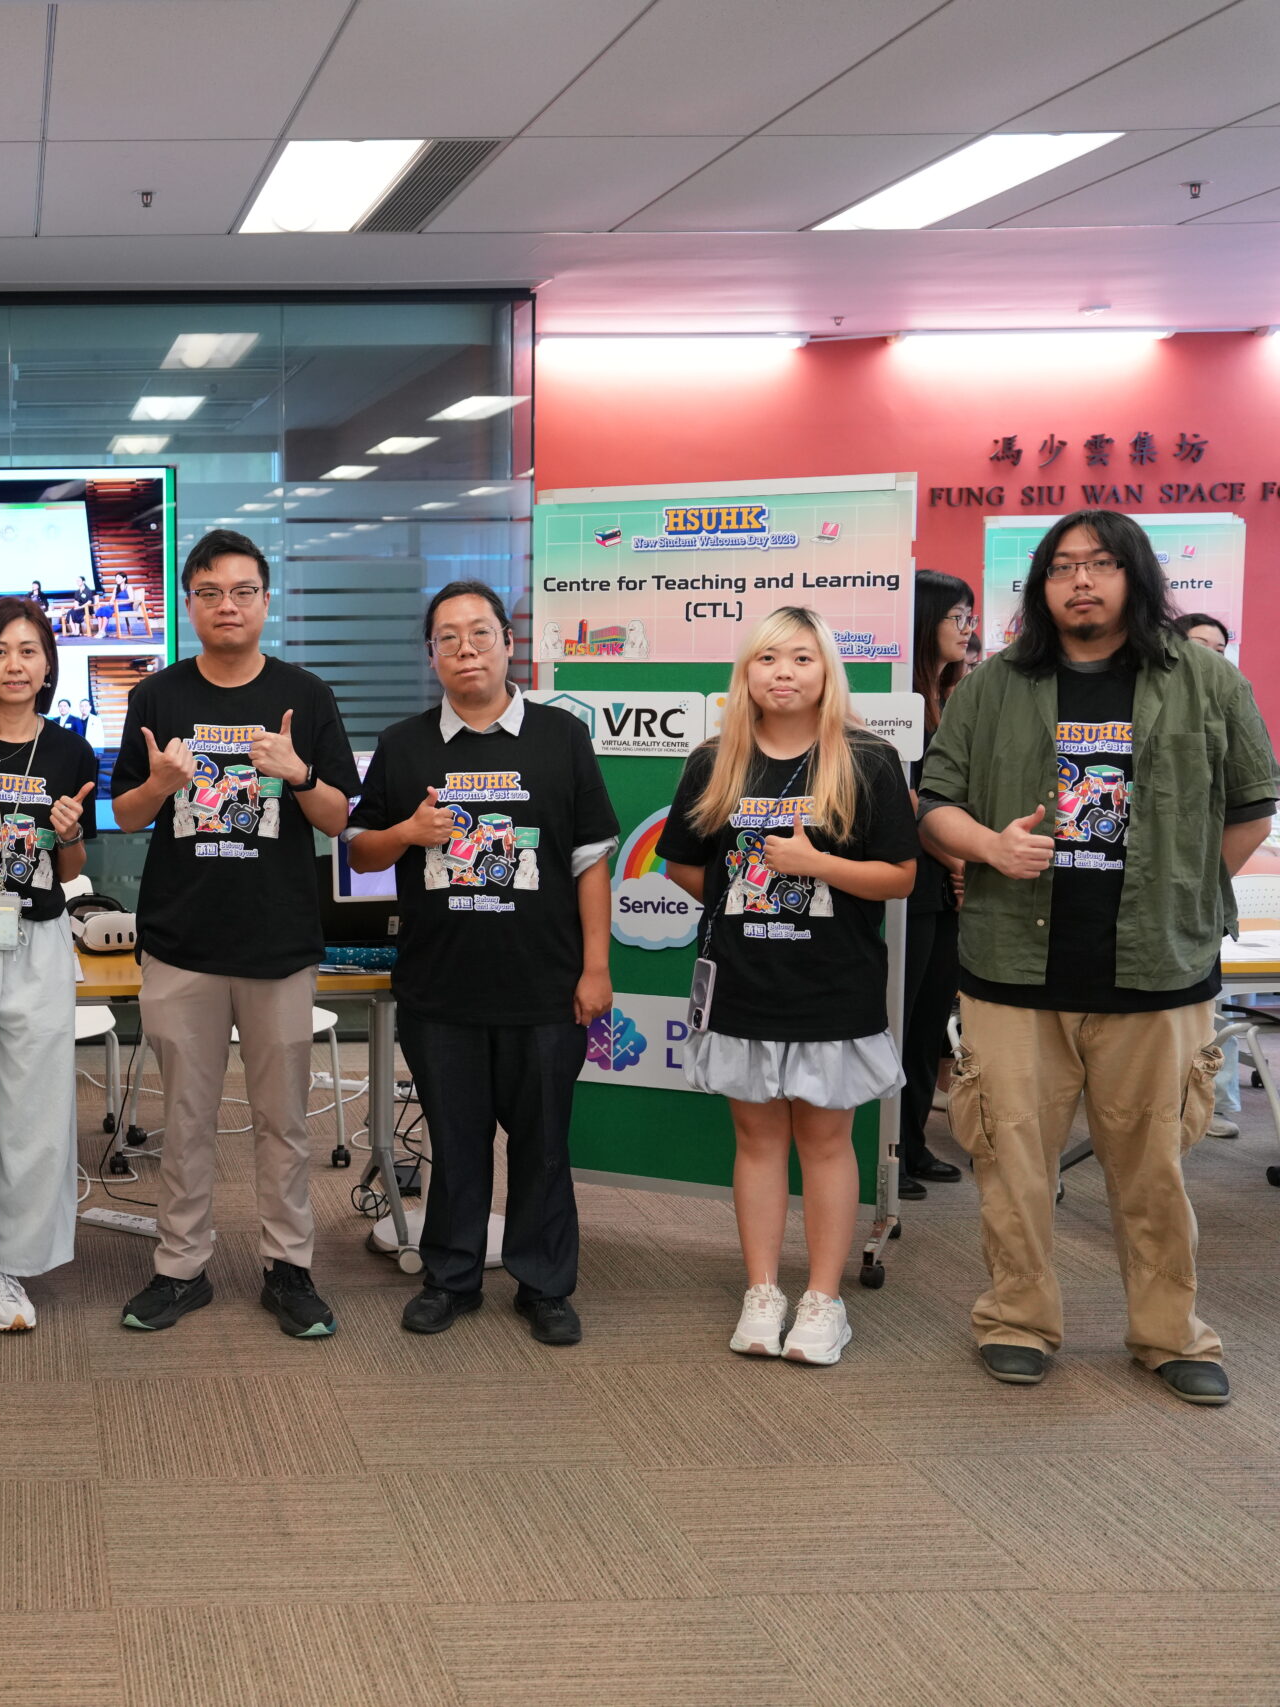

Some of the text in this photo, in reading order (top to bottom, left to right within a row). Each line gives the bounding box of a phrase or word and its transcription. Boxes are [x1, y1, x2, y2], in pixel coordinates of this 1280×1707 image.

[989, 431, 1209, 468] 馮少雲集坊
[929, 486, 1005, 507] FUNG
[1020, 485, 1066, 506] SIU
[1082, 484, 1144, 505] WAN
[1158, 482, 1246, 504] SPACE
[665, 506, 766, 535] HSUHK
[634, 534, 796, 548] New Student Welcome Day 2026
[543, 571, 900, 593] Centre for Teaching and Learning
[833, 631, 872, 645] Belong
[564, 642, 625, 656] HSUHK
[839, 644, 898, 657] nd Beyond
[602, 703, 686, 738] VRC
[865, 718, 913, 731] Learning
[1056, 724, 1133, 743] HSUHK
[186, 740, 252, 752] Welcome Fes
[1056, 740, 1097, 753] elcome
[1098, 740, 1123, 751] Fest
[447, 773, 519, 791] HSUHK
[438, 790, 486, 801] Welcome
[488, 790, 509, 800] Fest
[741, 799, 812, 816] HSUHK
[619, 896, 689, 914] Service
